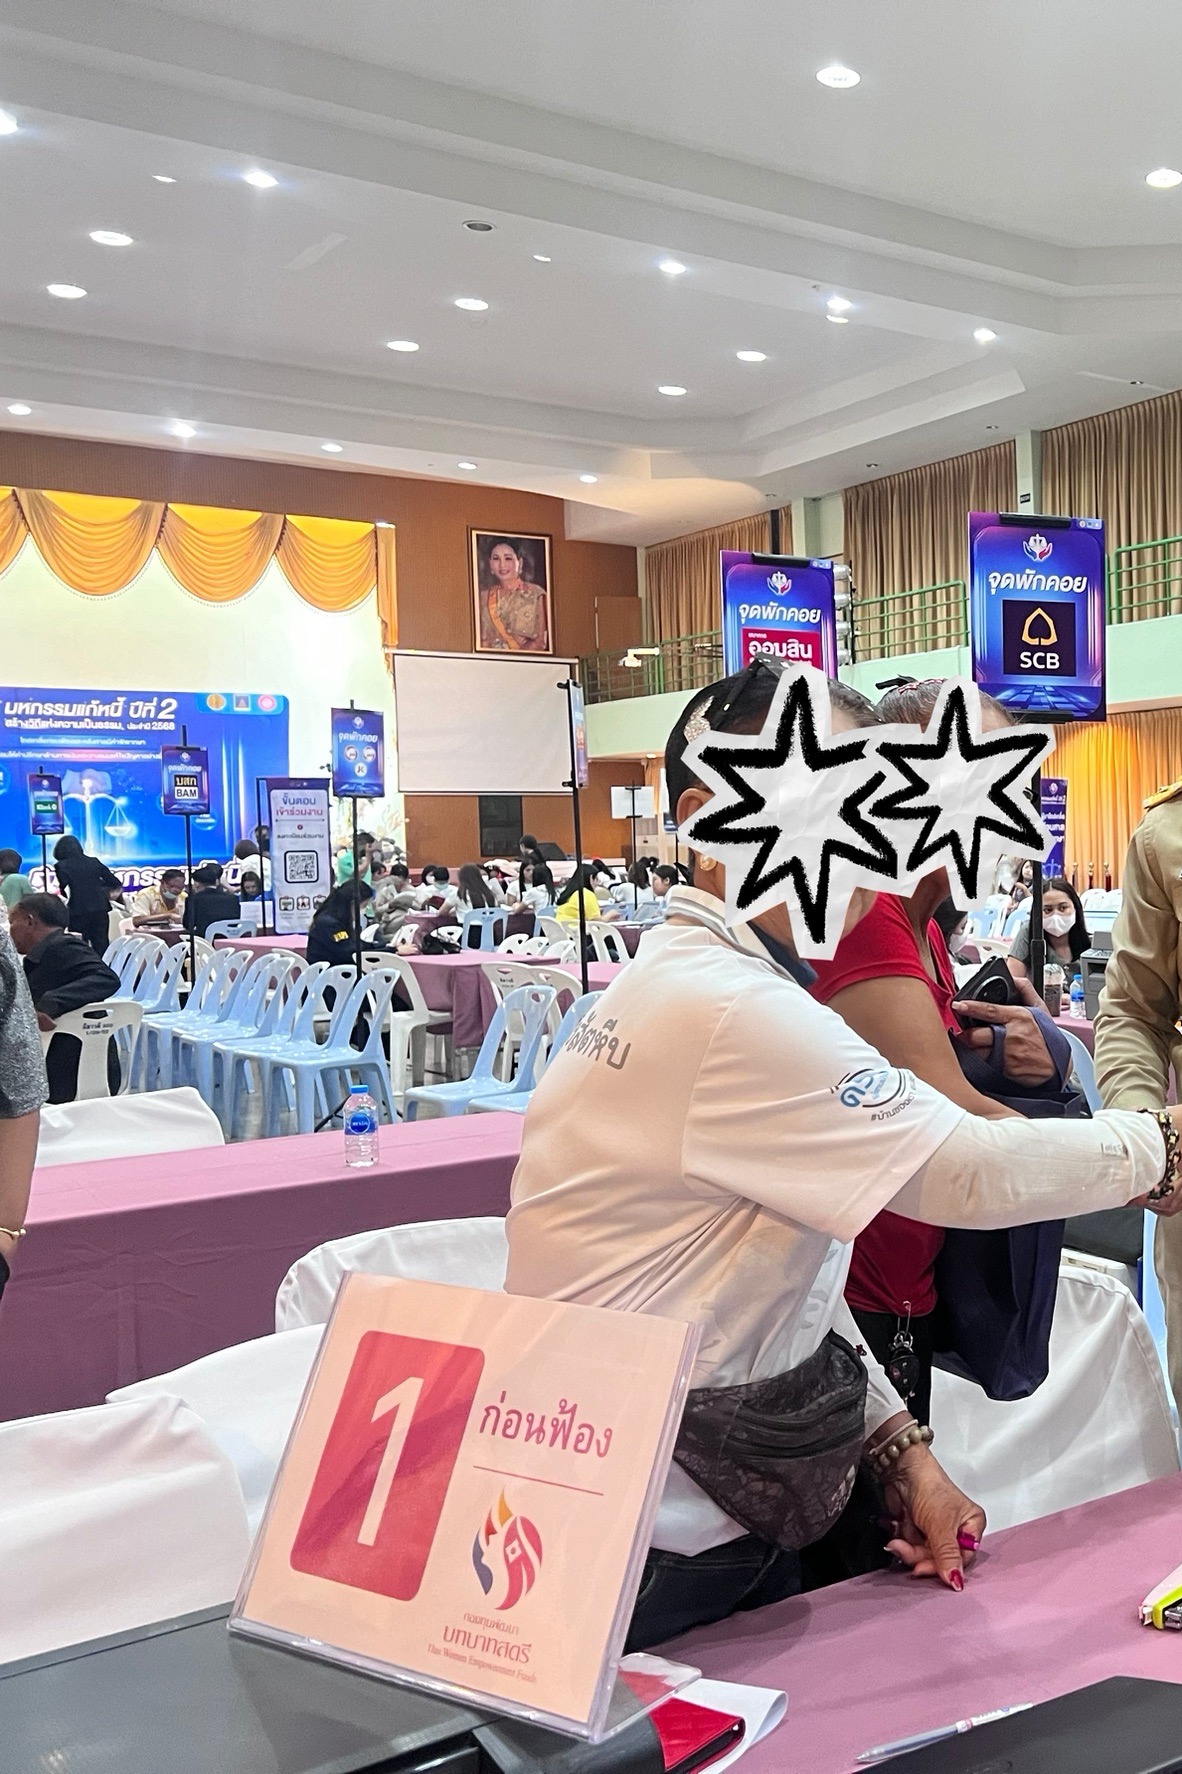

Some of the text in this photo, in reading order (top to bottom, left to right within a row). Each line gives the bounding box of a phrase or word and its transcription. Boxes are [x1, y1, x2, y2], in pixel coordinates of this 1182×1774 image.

[988, 568, 1088, 595] จุดพักคอย
[738, 601, 821, 624] จุดพักคอย
[748, 638, 813, 659] ออมสิน
[1019, 651, 1060, 669] SCB
[4, 697, 178, 720] มหกรรมแก้หนี้ ปีที่ 2
[338, 731, 378, 743] จุดพักคอย
[175, 777, 197, 786] บสก
[176, 788, 197, 798] BAM
[281, 792, 316, 805] ขั้นตอน
[276, 806, 323, 816] เข้าร่วมงาน
[479, 1390, 613, 1458] ก่อนฟ้อง
[357, 1376, 425, 1547] 1
[463, 1612, 520, 1636] กองทุนพัฒนา
[442, 1647, 467, 1663] Women
[443, 1625, 532, 1664] บทบาทสตรี
